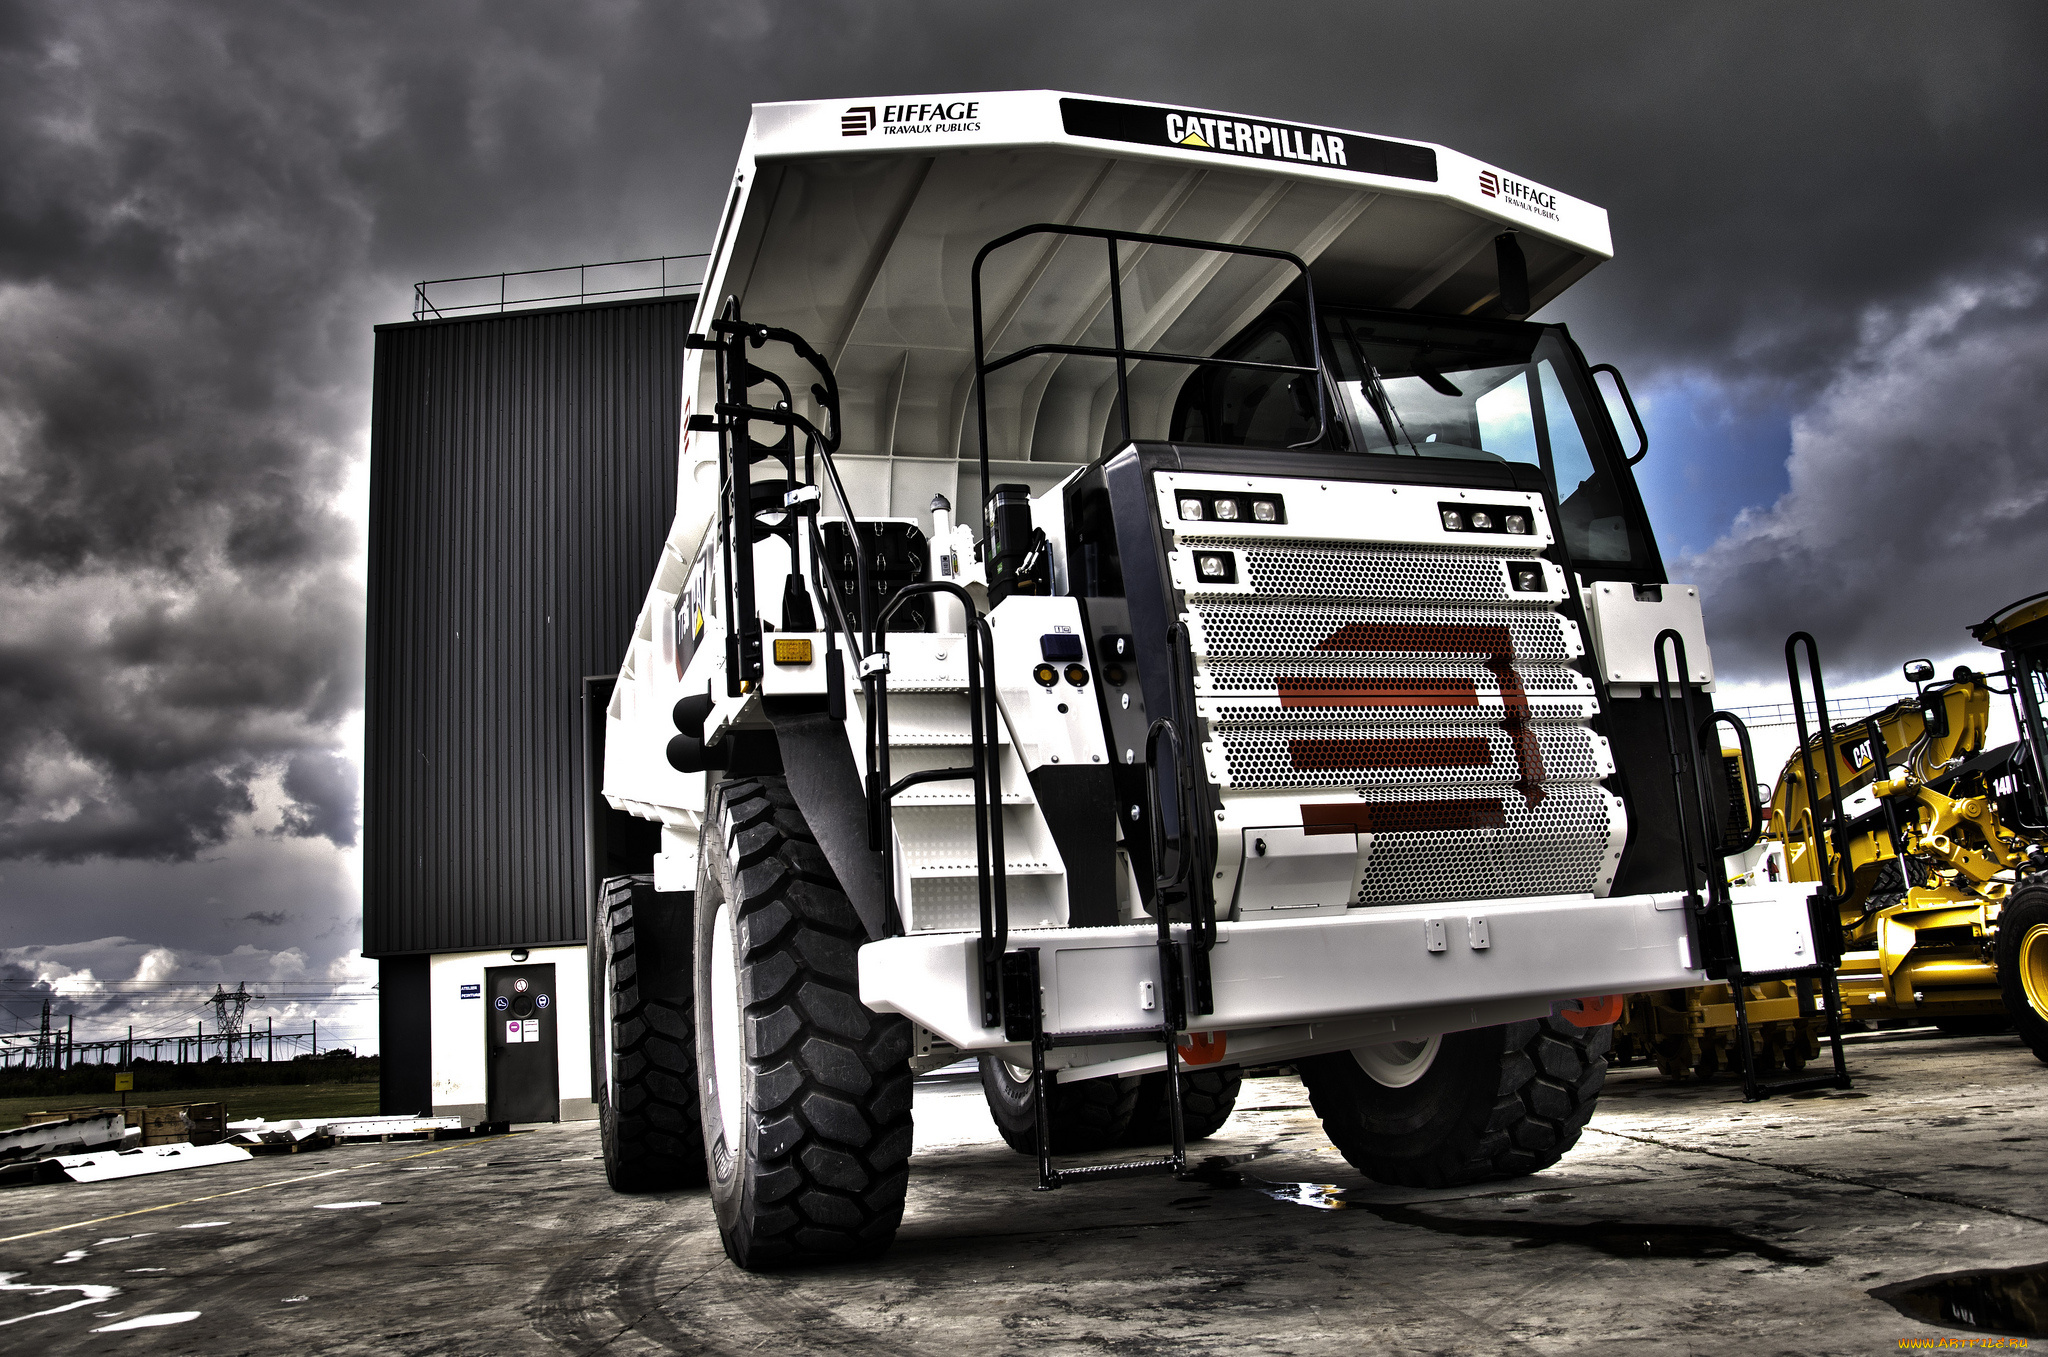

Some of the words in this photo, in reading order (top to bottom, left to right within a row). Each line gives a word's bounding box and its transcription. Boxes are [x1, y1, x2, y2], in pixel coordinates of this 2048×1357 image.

[883, 101, 980, 123] EIFFAGE
[883, 123, 932, 135] TRAVAUX
[935, 121, 982, 133] PUBLICS
[1166, 113, 1348, 166] CATERPILLAR
[1503, 177, 1557, 211] EIFFAGE
[1505, 195, 1533, 213] TRAVAUX
[1533, 206, 1560, 222] PUBLICS
[1853, 739, 1873, 768] CAT
